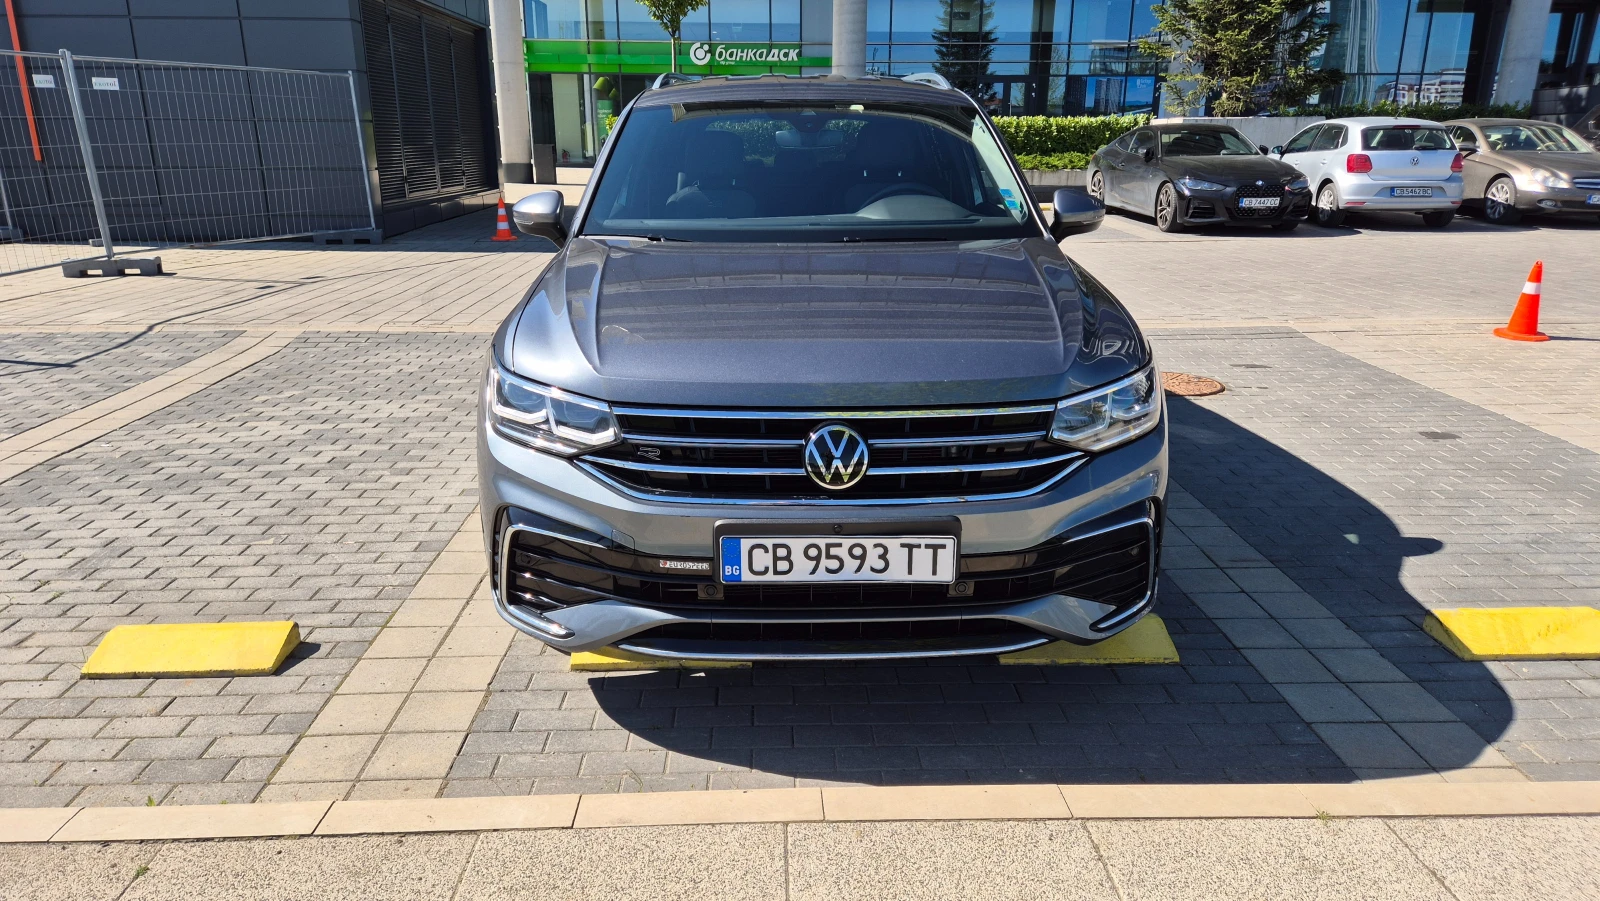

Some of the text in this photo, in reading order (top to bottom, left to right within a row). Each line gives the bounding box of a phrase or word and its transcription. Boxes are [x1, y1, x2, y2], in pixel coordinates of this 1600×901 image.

[747, 542, 947, 576] CB 9593 TT
[725, 565, 740, 576] BG
